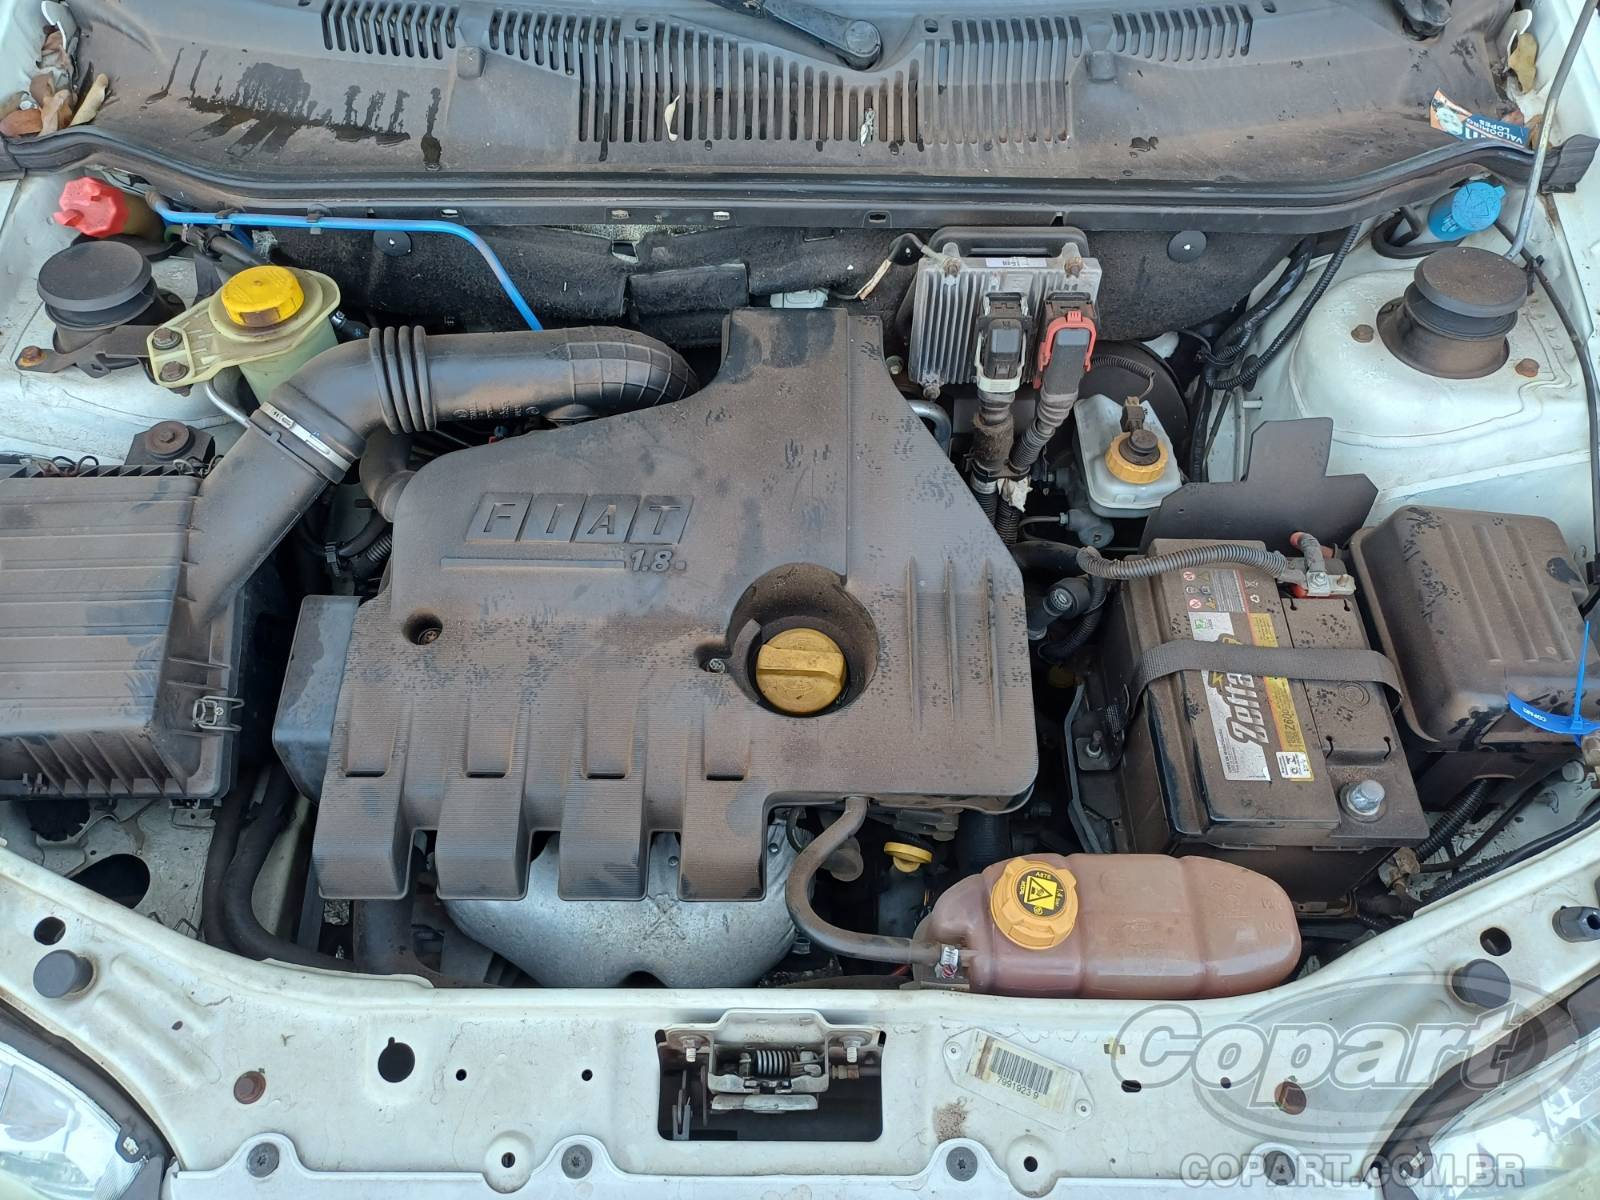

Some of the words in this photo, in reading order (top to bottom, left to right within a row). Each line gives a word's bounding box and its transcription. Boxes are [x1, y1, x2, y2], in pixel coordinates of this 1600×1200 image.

[480, 500, 684, 538] FIAT
[630, 549, 673, 573] 1.8
[1225, 673, 1269, 744] Zetta
